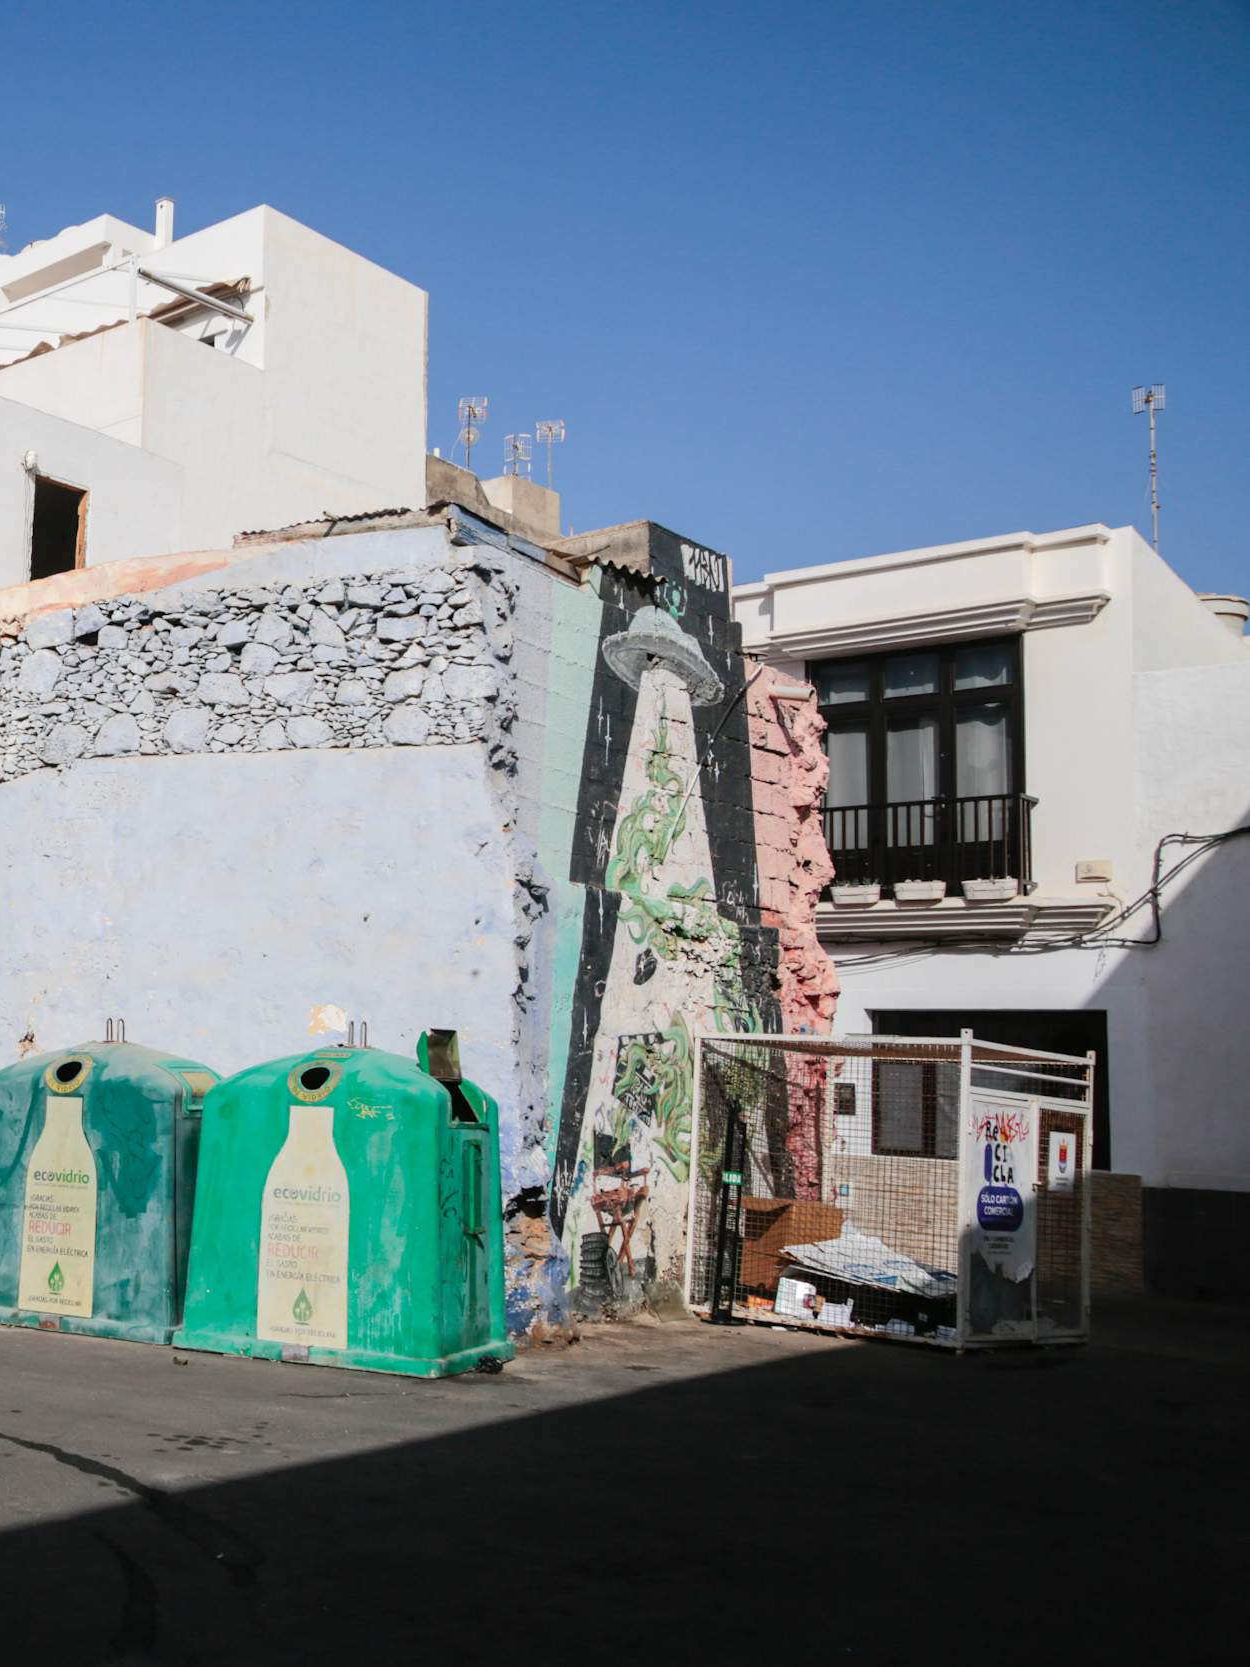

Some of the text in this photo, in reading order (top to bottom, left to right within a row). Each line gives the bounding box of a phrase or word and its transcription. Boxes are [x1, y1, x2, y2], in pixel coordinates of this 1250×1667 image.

[33, 1169, 90, 1184] ecovidrio
[993, 1164, 1014, 1184] CLA
[273, 1186, 342, 1202] ecovidrio
[28, 1219, 72, 1236] REDUCIR
[267, 1242, 319, 1259] REDUCIR
